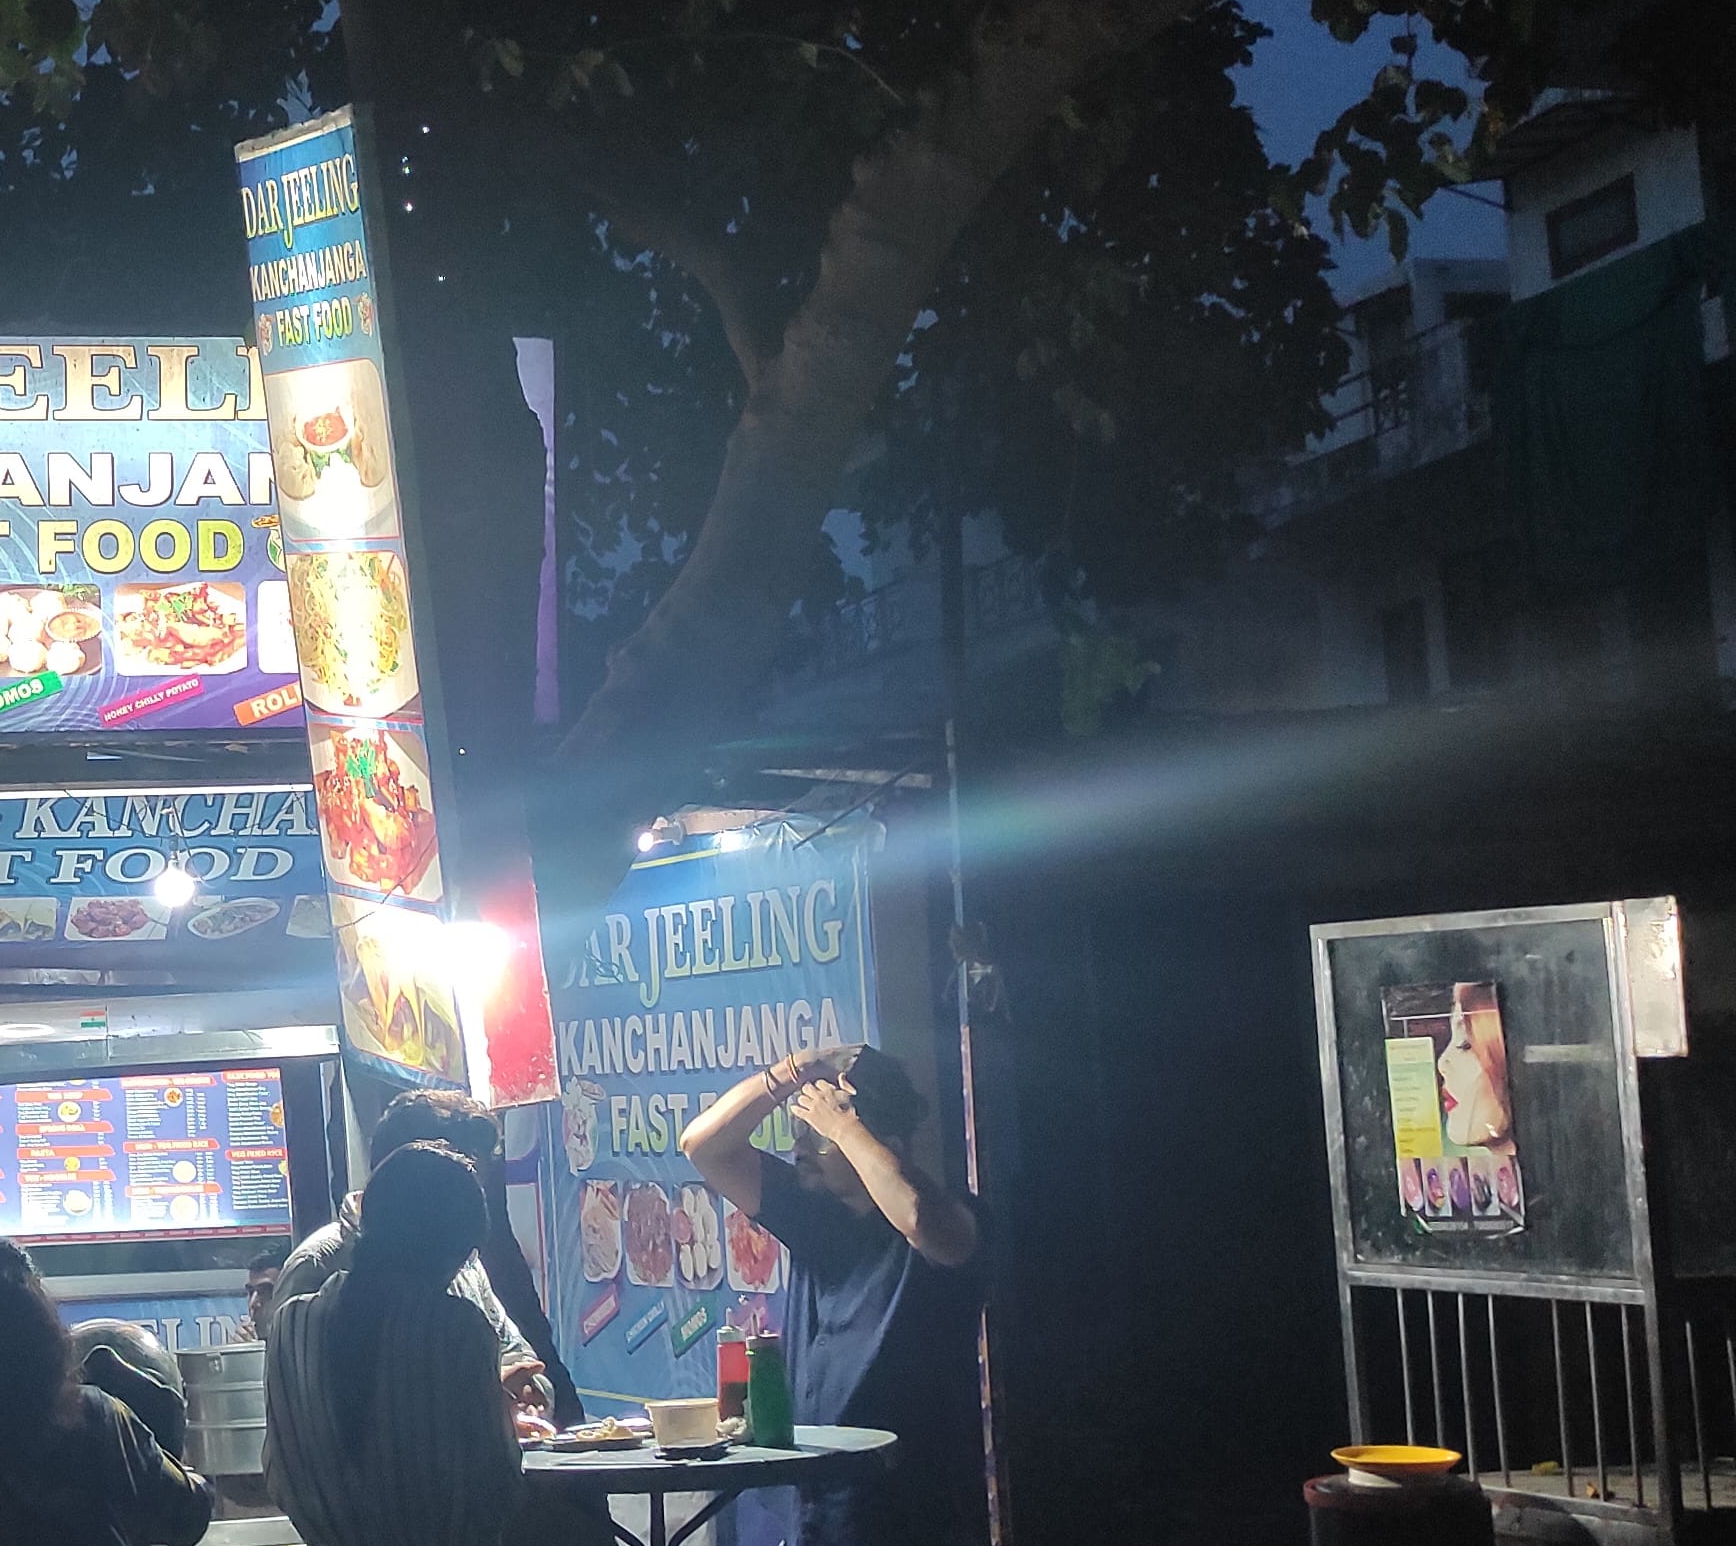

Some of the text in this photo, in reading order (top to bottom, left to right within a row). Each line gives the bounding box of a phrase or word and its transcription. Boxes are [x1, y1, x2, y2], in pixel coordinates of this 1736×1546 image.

[241, 154, 360, 250] DARJEELING
[250, 240, 368, 303] KANCHANJANGA
[275, 296, 354, 347] FAST FOOD
[36, 518, 245, 575] FOOD
[49, 846, 294, 884] FOOD
[611, 1093, 689, 1153] FAST
